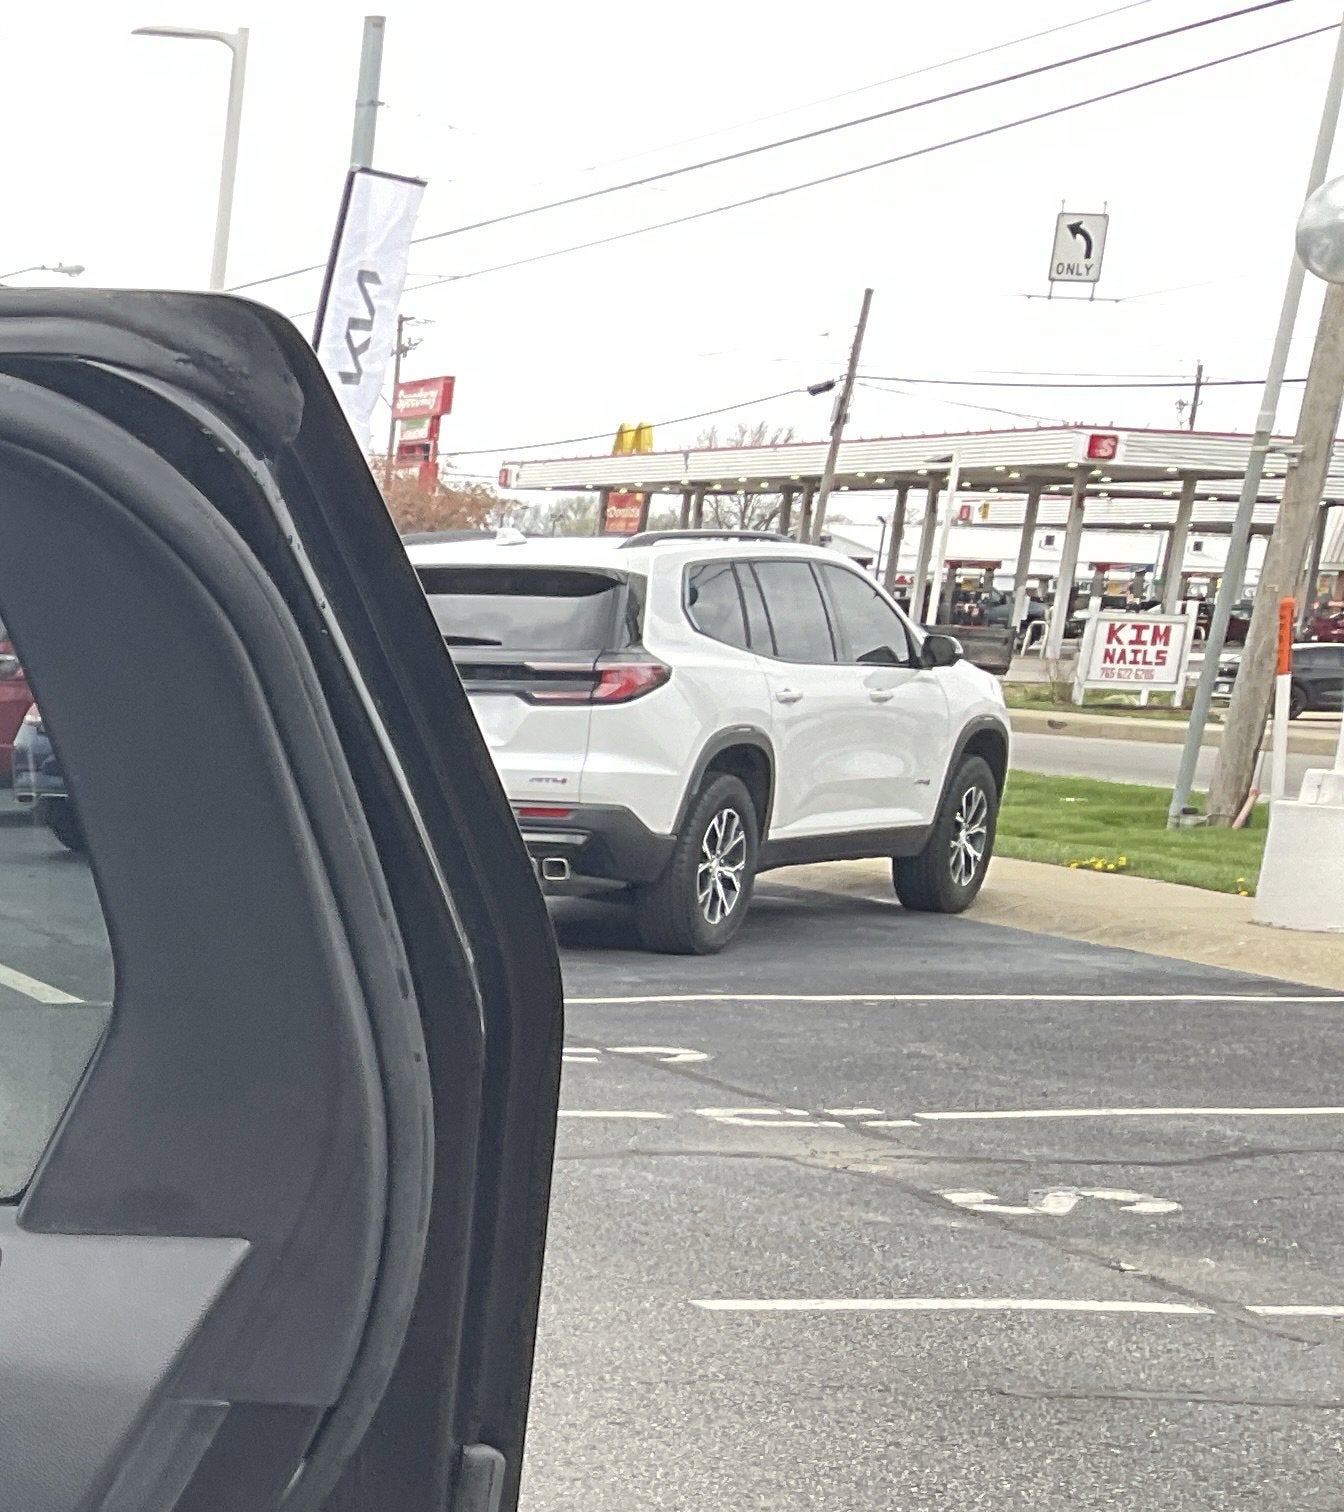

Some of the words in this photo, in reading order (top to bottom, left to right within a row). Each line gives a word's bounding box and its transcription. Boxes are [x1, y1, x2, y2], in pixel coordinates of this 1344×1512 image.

[1056, 262, 1094, 277] ONLY
[1106, 623, 1172, 646] KIM
[1103, 648, 1168, 666] NAILS
